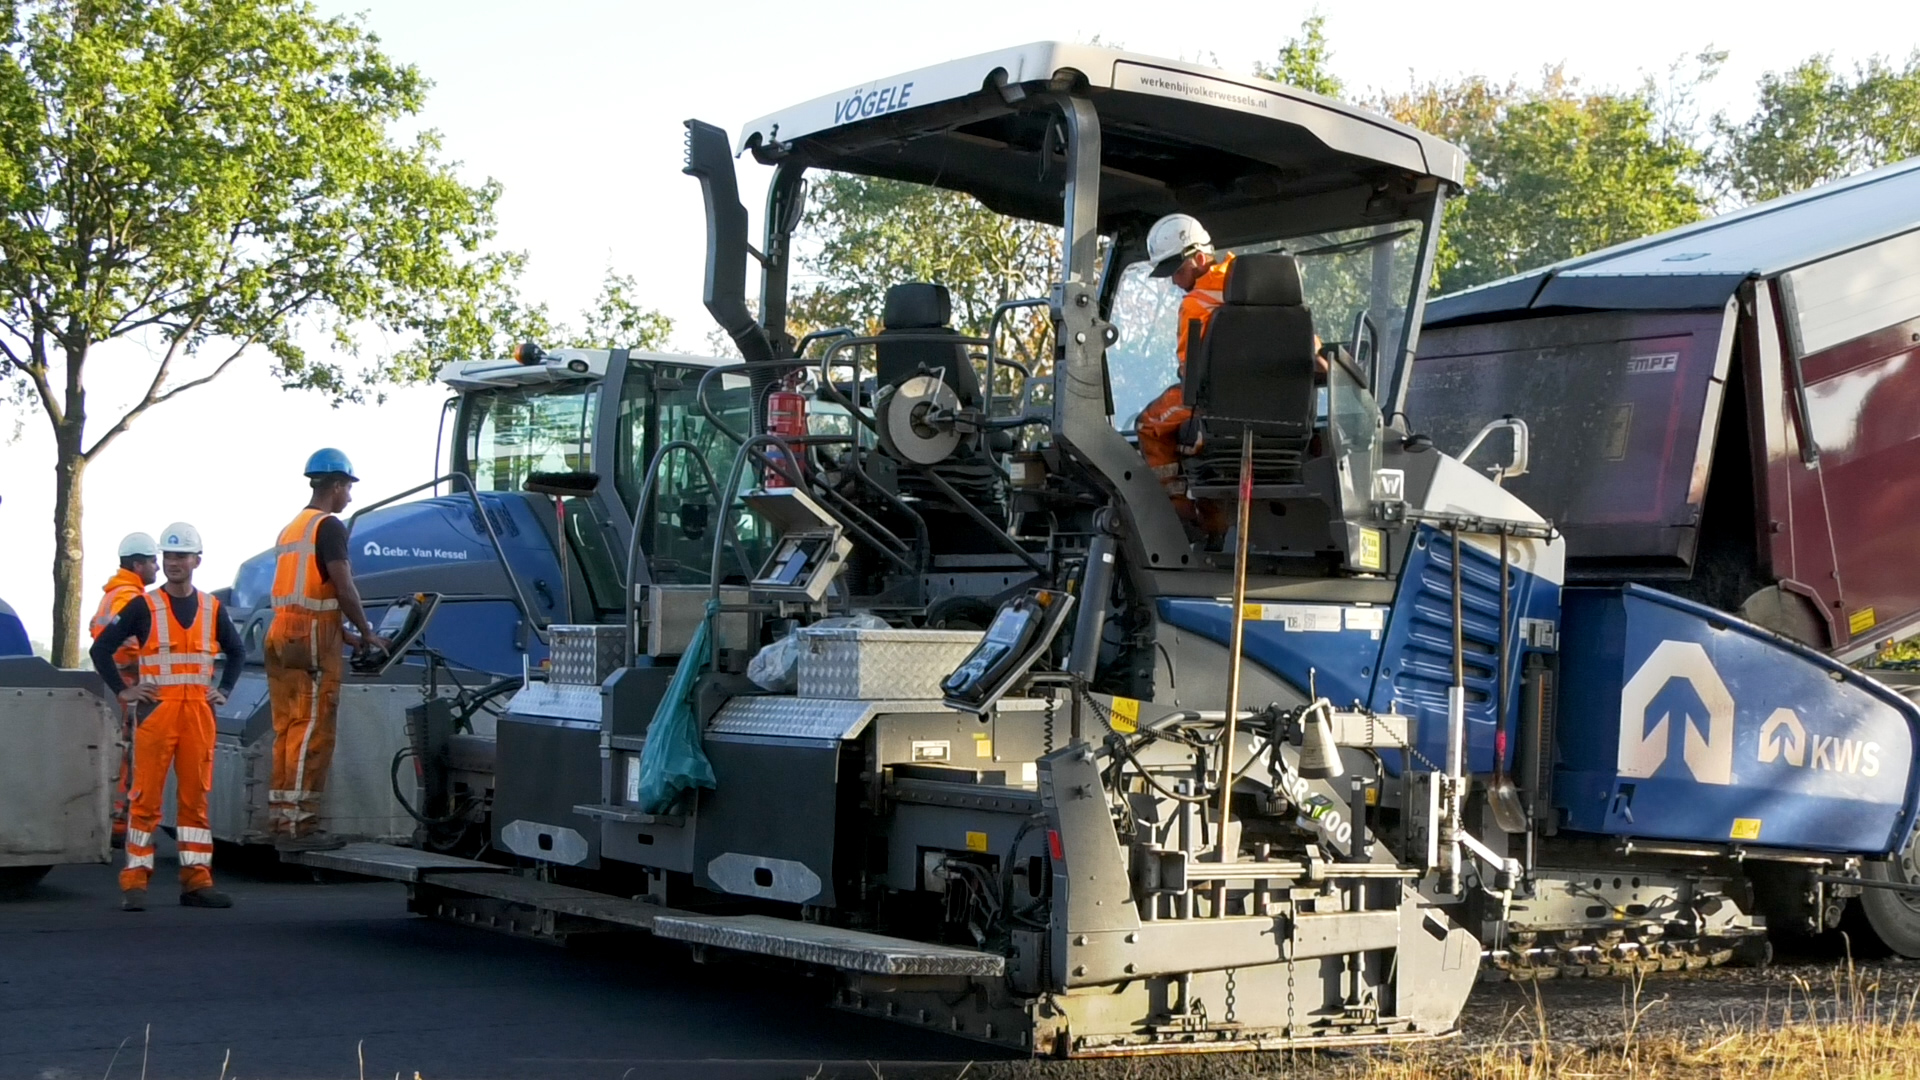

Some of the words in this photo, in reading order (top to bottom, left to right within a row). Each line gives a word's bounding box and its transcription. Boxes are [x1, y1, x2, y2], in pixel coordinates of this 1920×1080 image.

[834, 82, 914, 124] VÖGELE
[1140, 76, 1267, 109] werkenbijvolkerwessels.nl
[382, 546, 410, 557] Gebr.
[412, 547, 432, 558] Van
[434, 548, 467, 560] Kessel
[1810, 734, 1880, 777] KWS
